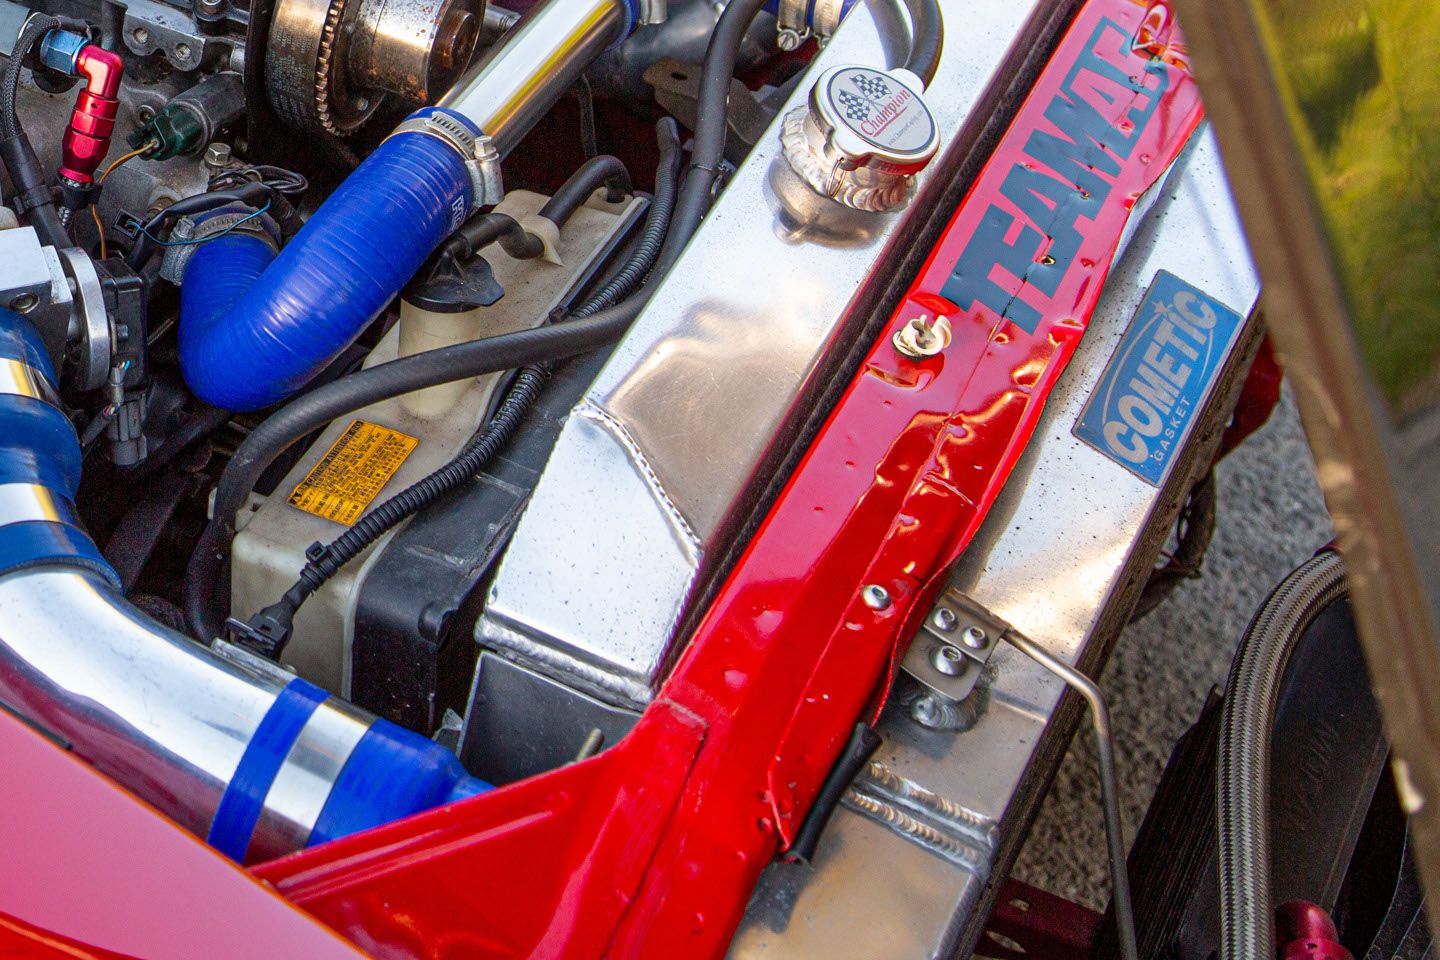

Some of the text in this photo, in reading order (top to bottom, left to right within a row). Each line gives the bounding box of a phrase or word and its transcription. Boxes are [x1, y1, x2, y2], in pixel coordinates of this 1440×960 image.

[860, 89, 910, 137] Champion
[1103, 290, 1217, 464] COMETIC
[1154, 398, 1191, 462] GASKET
